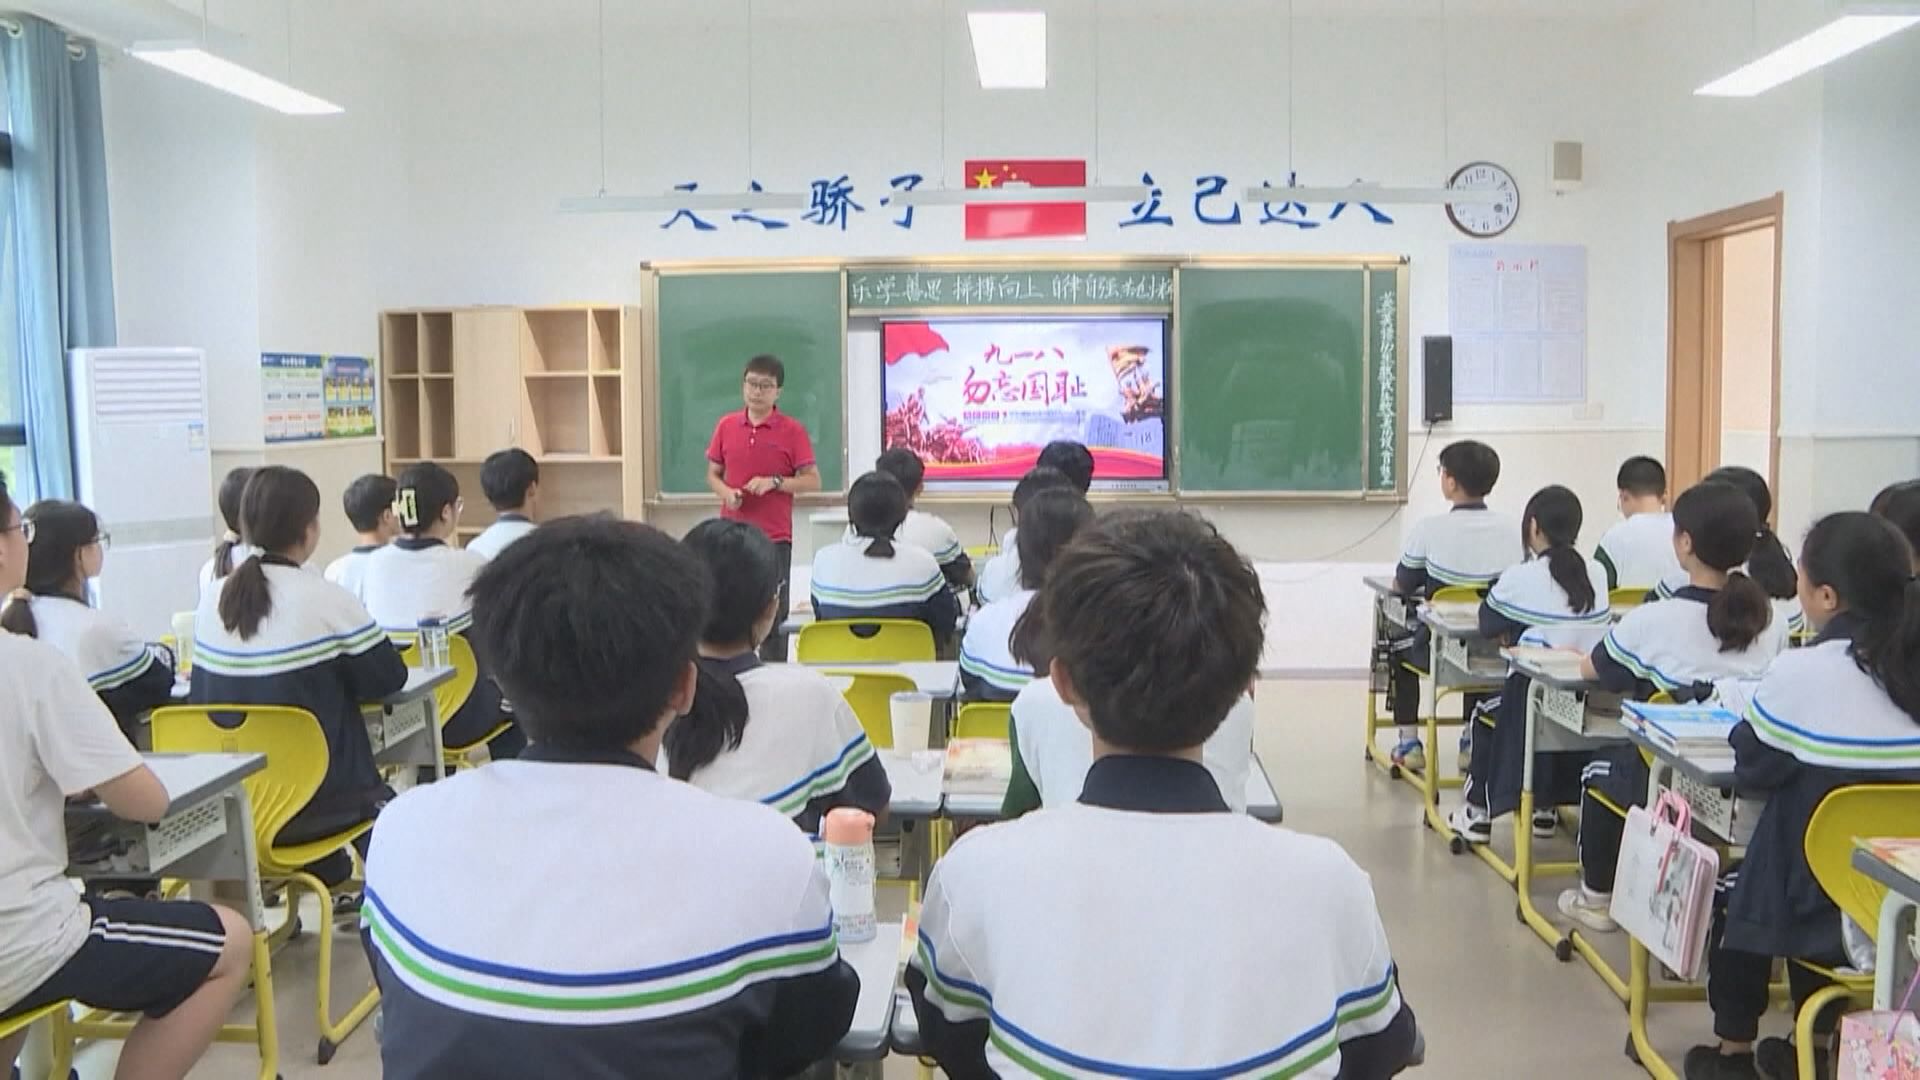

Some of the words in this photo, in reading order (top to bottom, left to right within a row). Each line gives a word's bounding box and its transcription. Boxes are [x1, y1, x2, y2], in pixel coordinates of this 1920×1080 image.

[952, 273, 1044, 304] 拼搏向上
[984, 343, 1065, 364] 九一八
[963, 366, 1088, 407] 勿忘国耻
